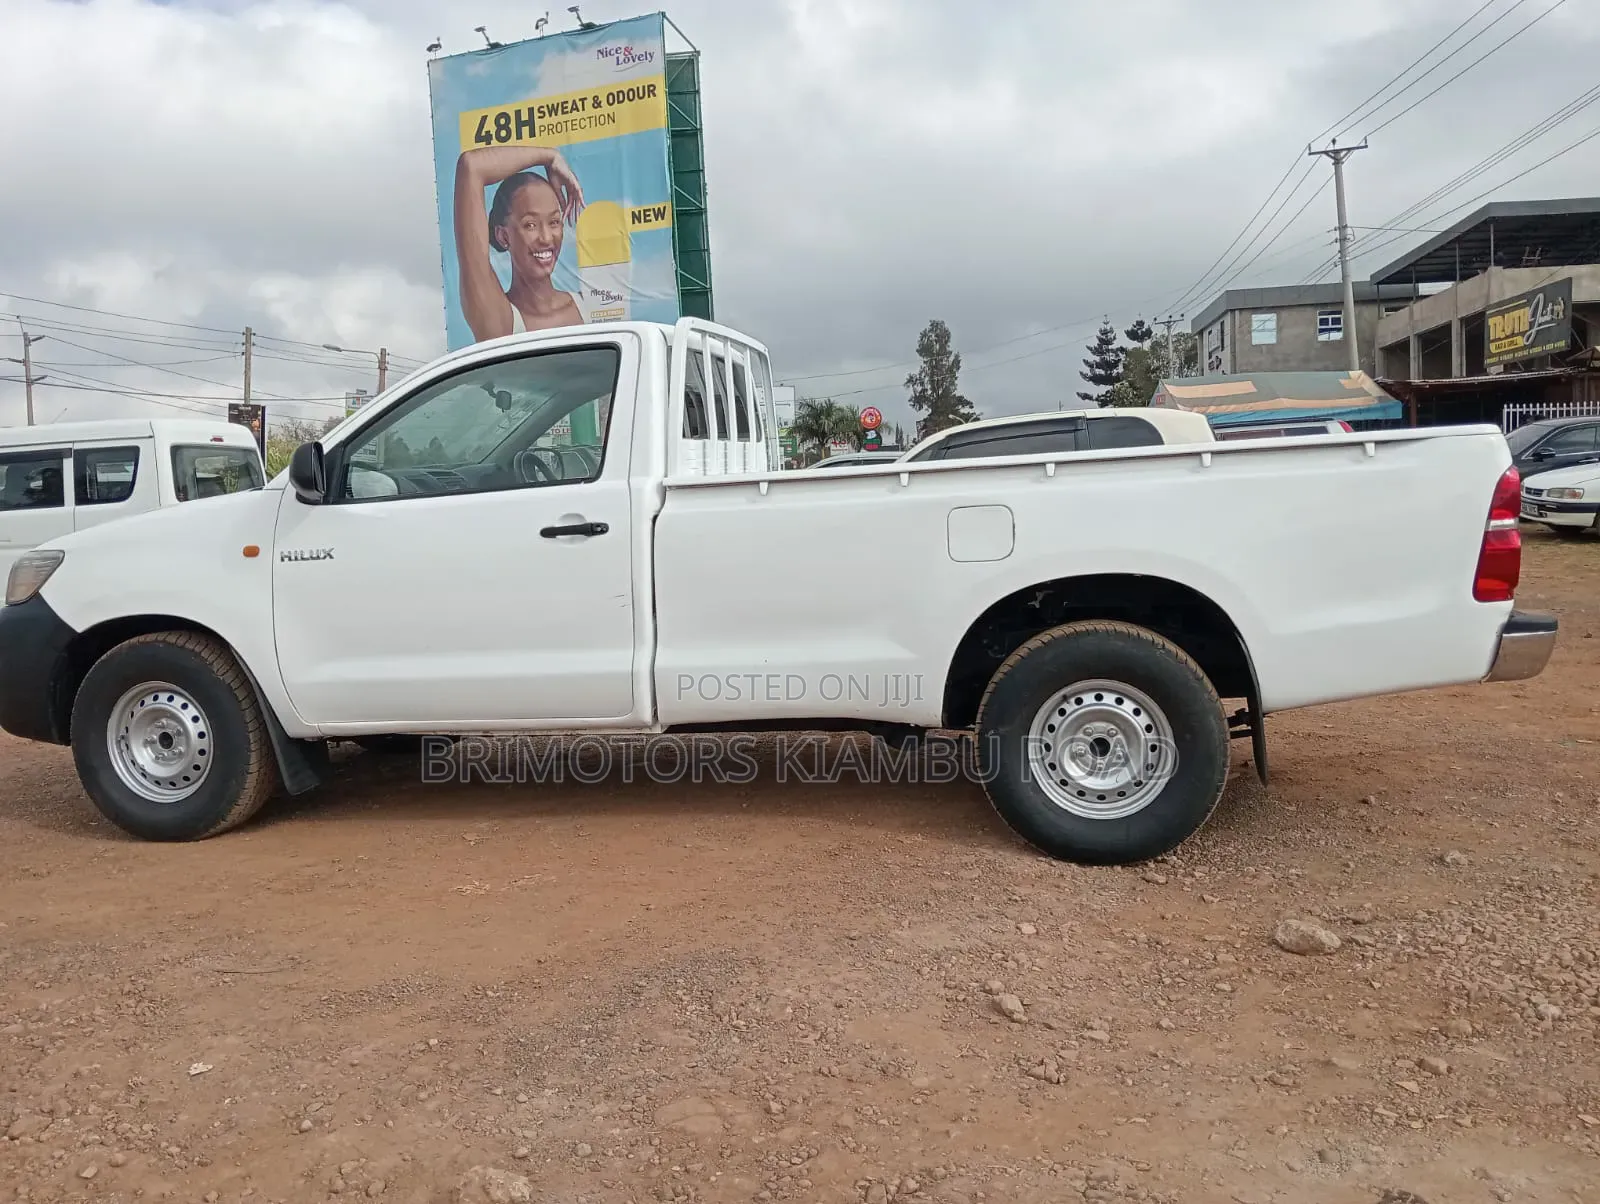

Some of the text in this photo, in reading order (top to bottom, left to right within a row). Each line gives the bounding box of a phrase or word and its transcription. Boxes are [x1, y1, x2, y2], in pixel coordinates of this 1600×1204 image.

[596, 44, 633, 60] Nice &
[615, 49, 655, 66] Lovely
[537, 84, 657, 119] SWEAT & ODOUR
[474, 106, 537, 146] 48H
[538, 112, 616, 137] PROTECTION
[631, 206, 667, 225] NEW
[1488, 307, 1530, 340] TRUTH
[280, 547, 335, 563] HILUX
